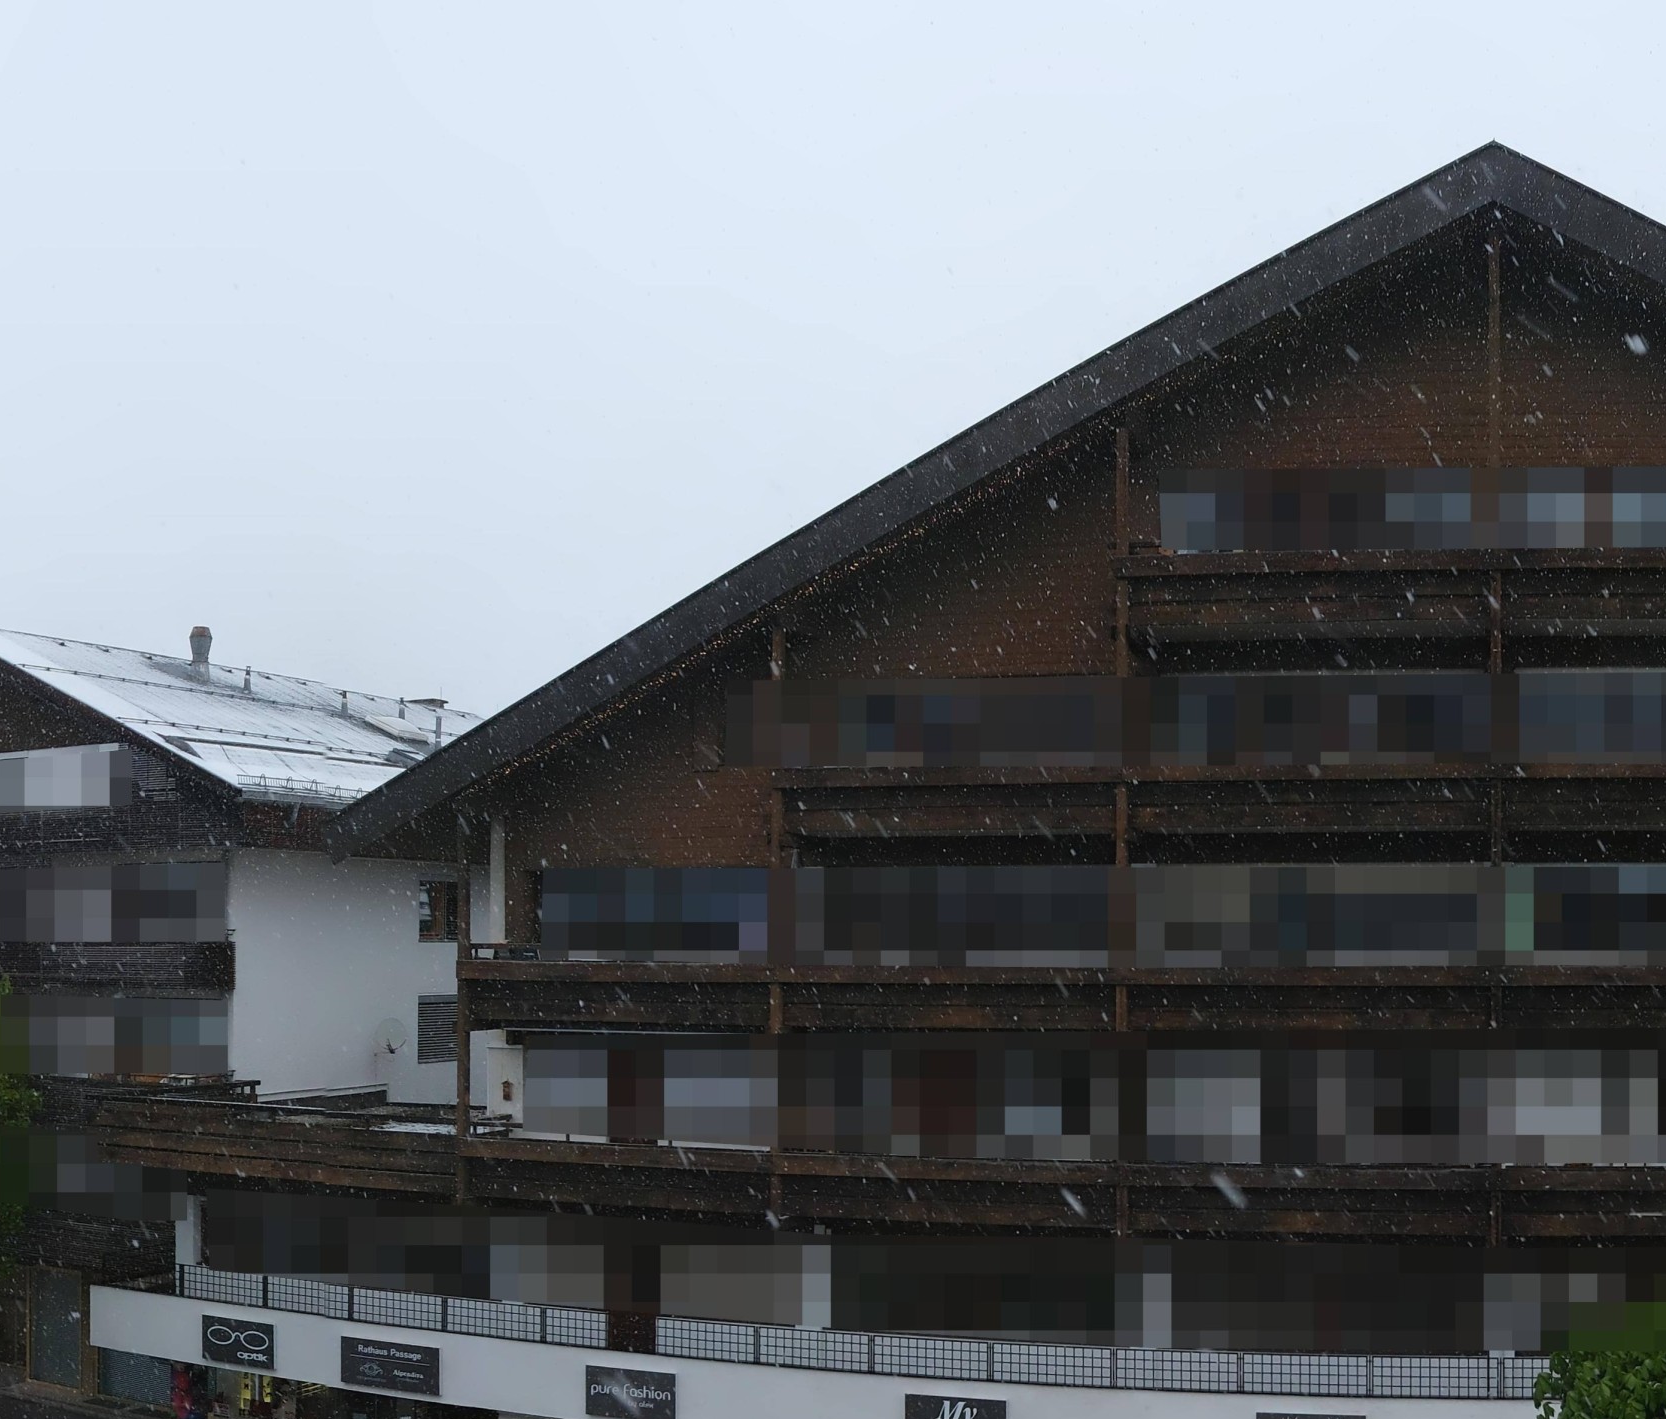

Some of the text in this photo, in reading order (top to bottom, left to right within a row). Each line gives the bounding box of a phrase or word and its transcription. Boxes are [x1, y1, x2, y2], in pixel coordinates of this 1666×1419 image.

[237, 1351, 268, 1363] optik
[358, 1344, 422, 1361] Rathaus Passage
[590, 1383, 671, 1401] pure fashion
